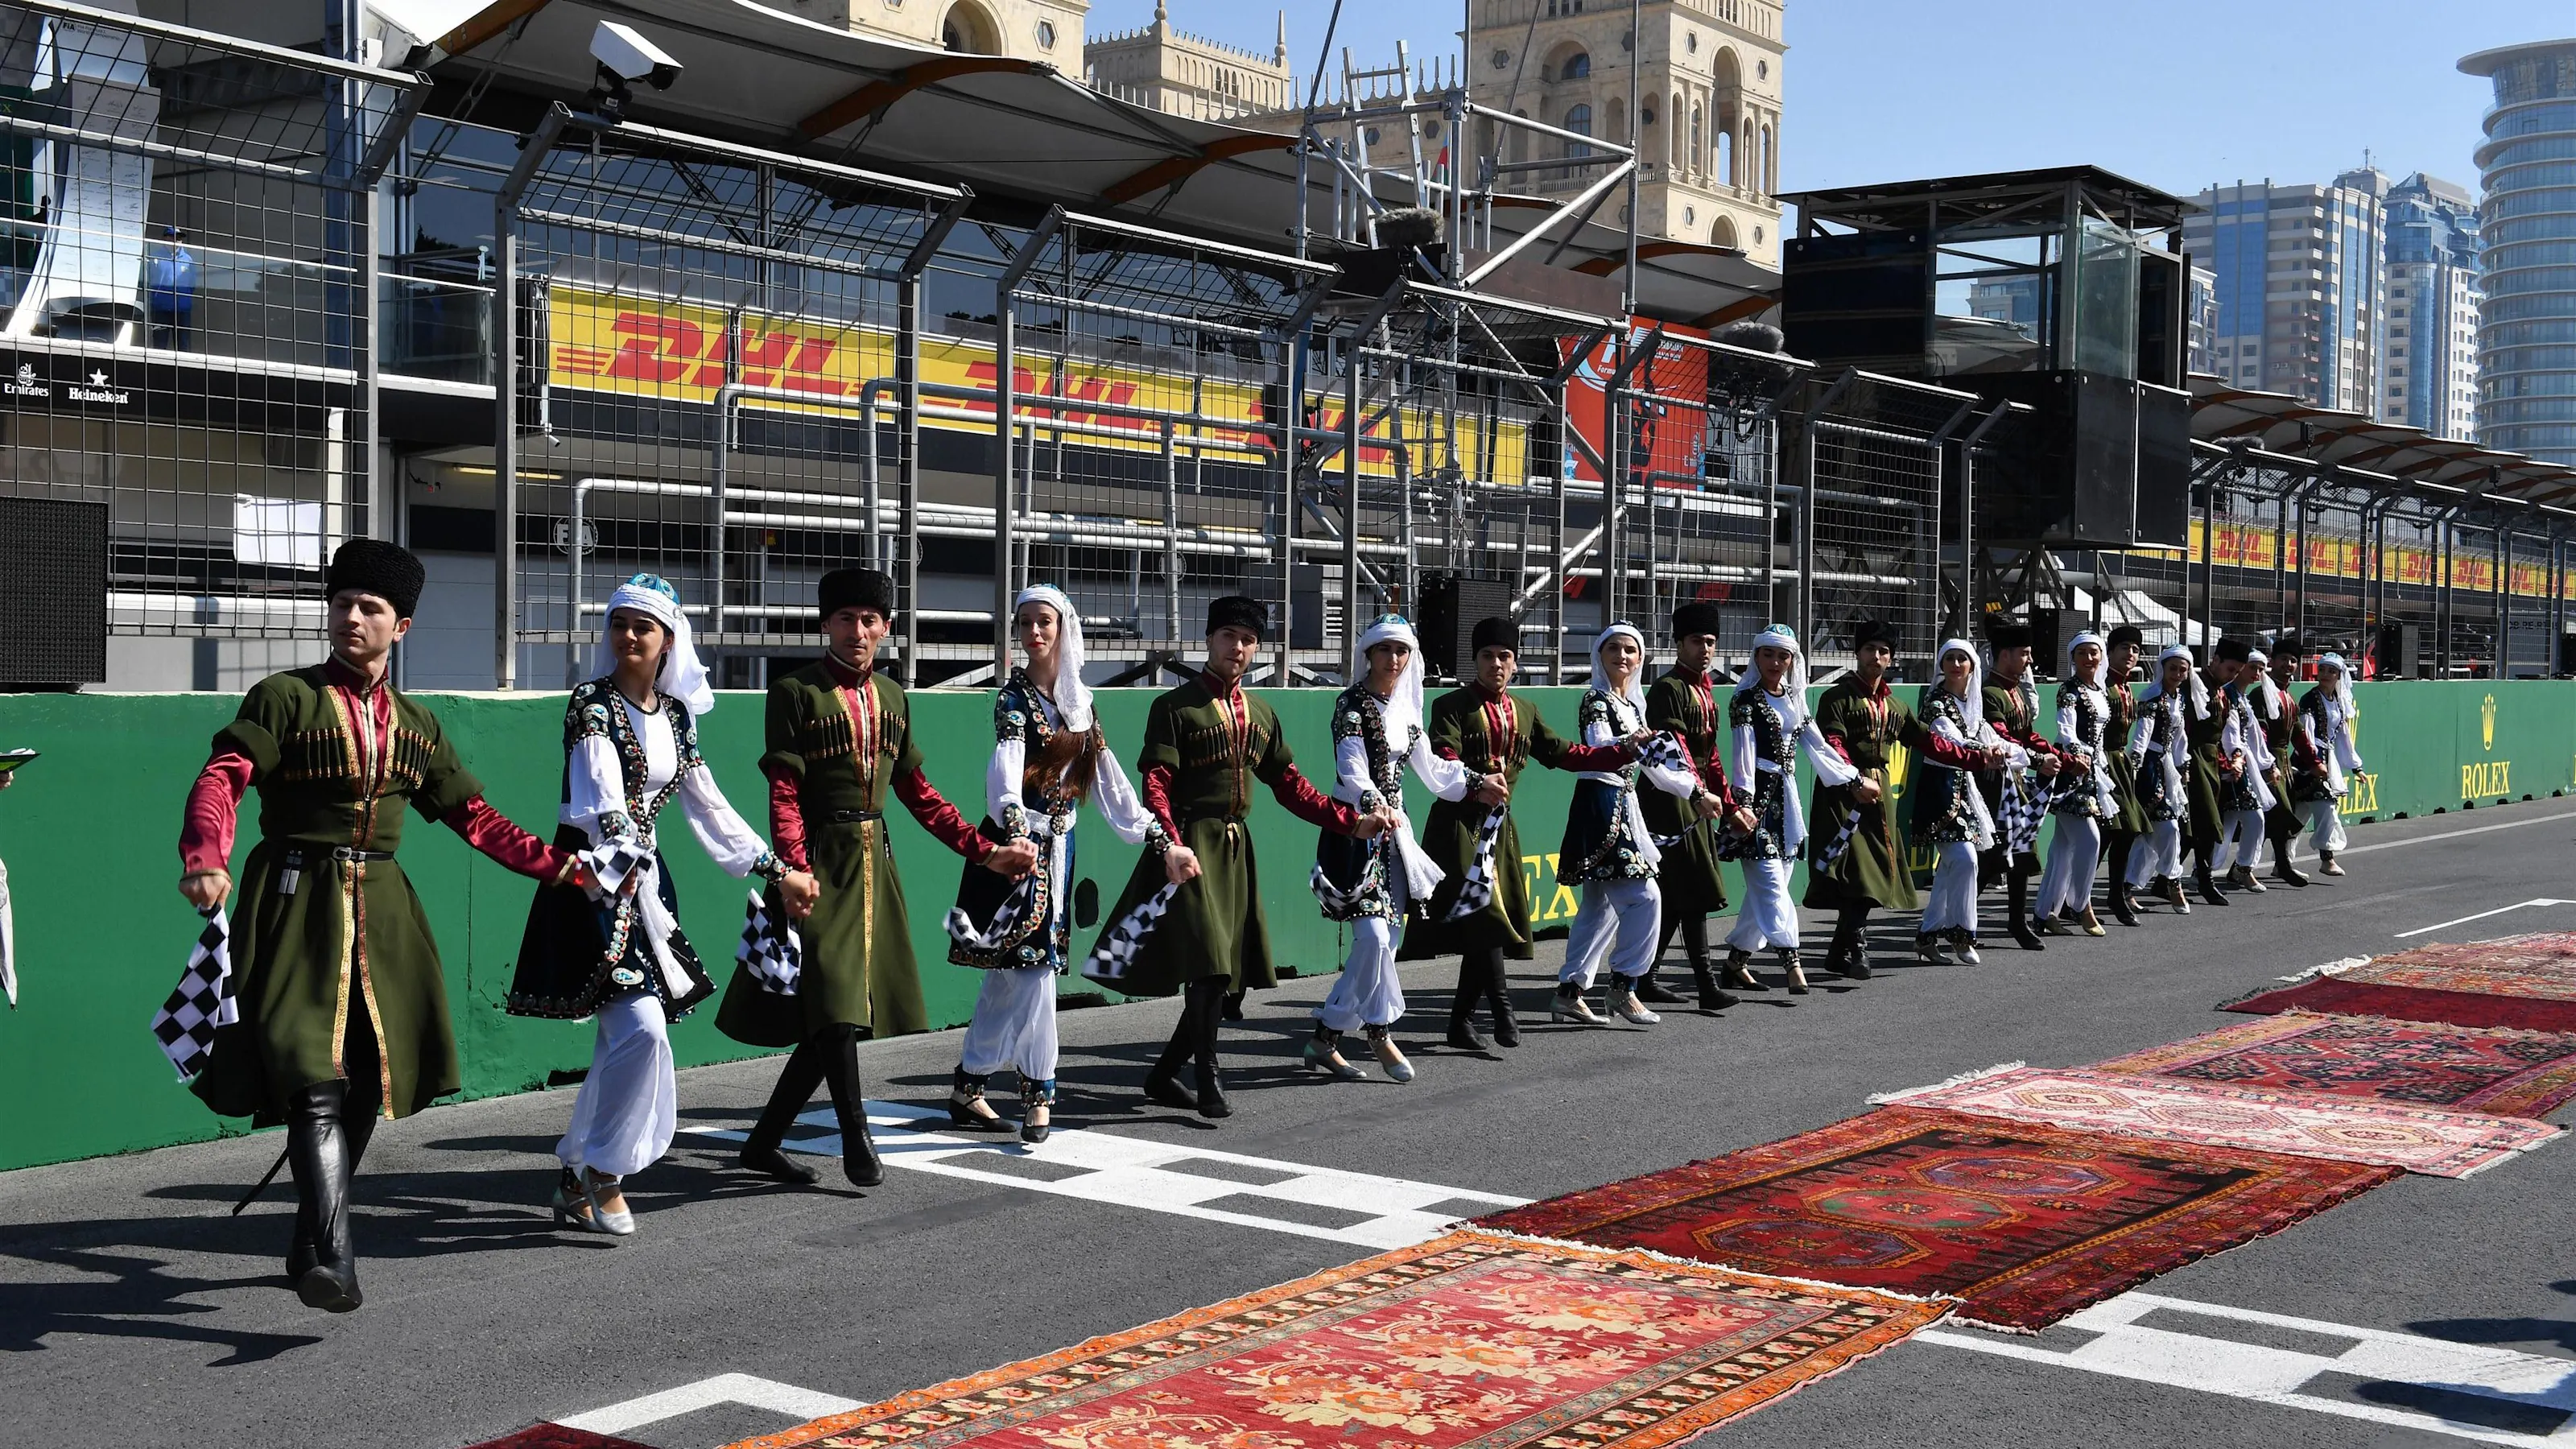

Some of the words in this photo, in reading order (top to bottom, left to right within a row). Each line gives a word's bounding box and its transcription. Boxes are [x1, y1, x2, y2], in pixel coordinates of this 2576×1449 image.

[606, 312, 848, 396] DHL
[4, 383, 49, 397] Emirates
[68, 387, 129, 404] Heineken
[964, 361, 1145, 430] DHL
[557, 523, 594, 547] FA
[2219, 531, 2260, 563] DHL
[2337, 774, 2379, 815] LEX
[2462, 761, 2510, 799] ROLEX
